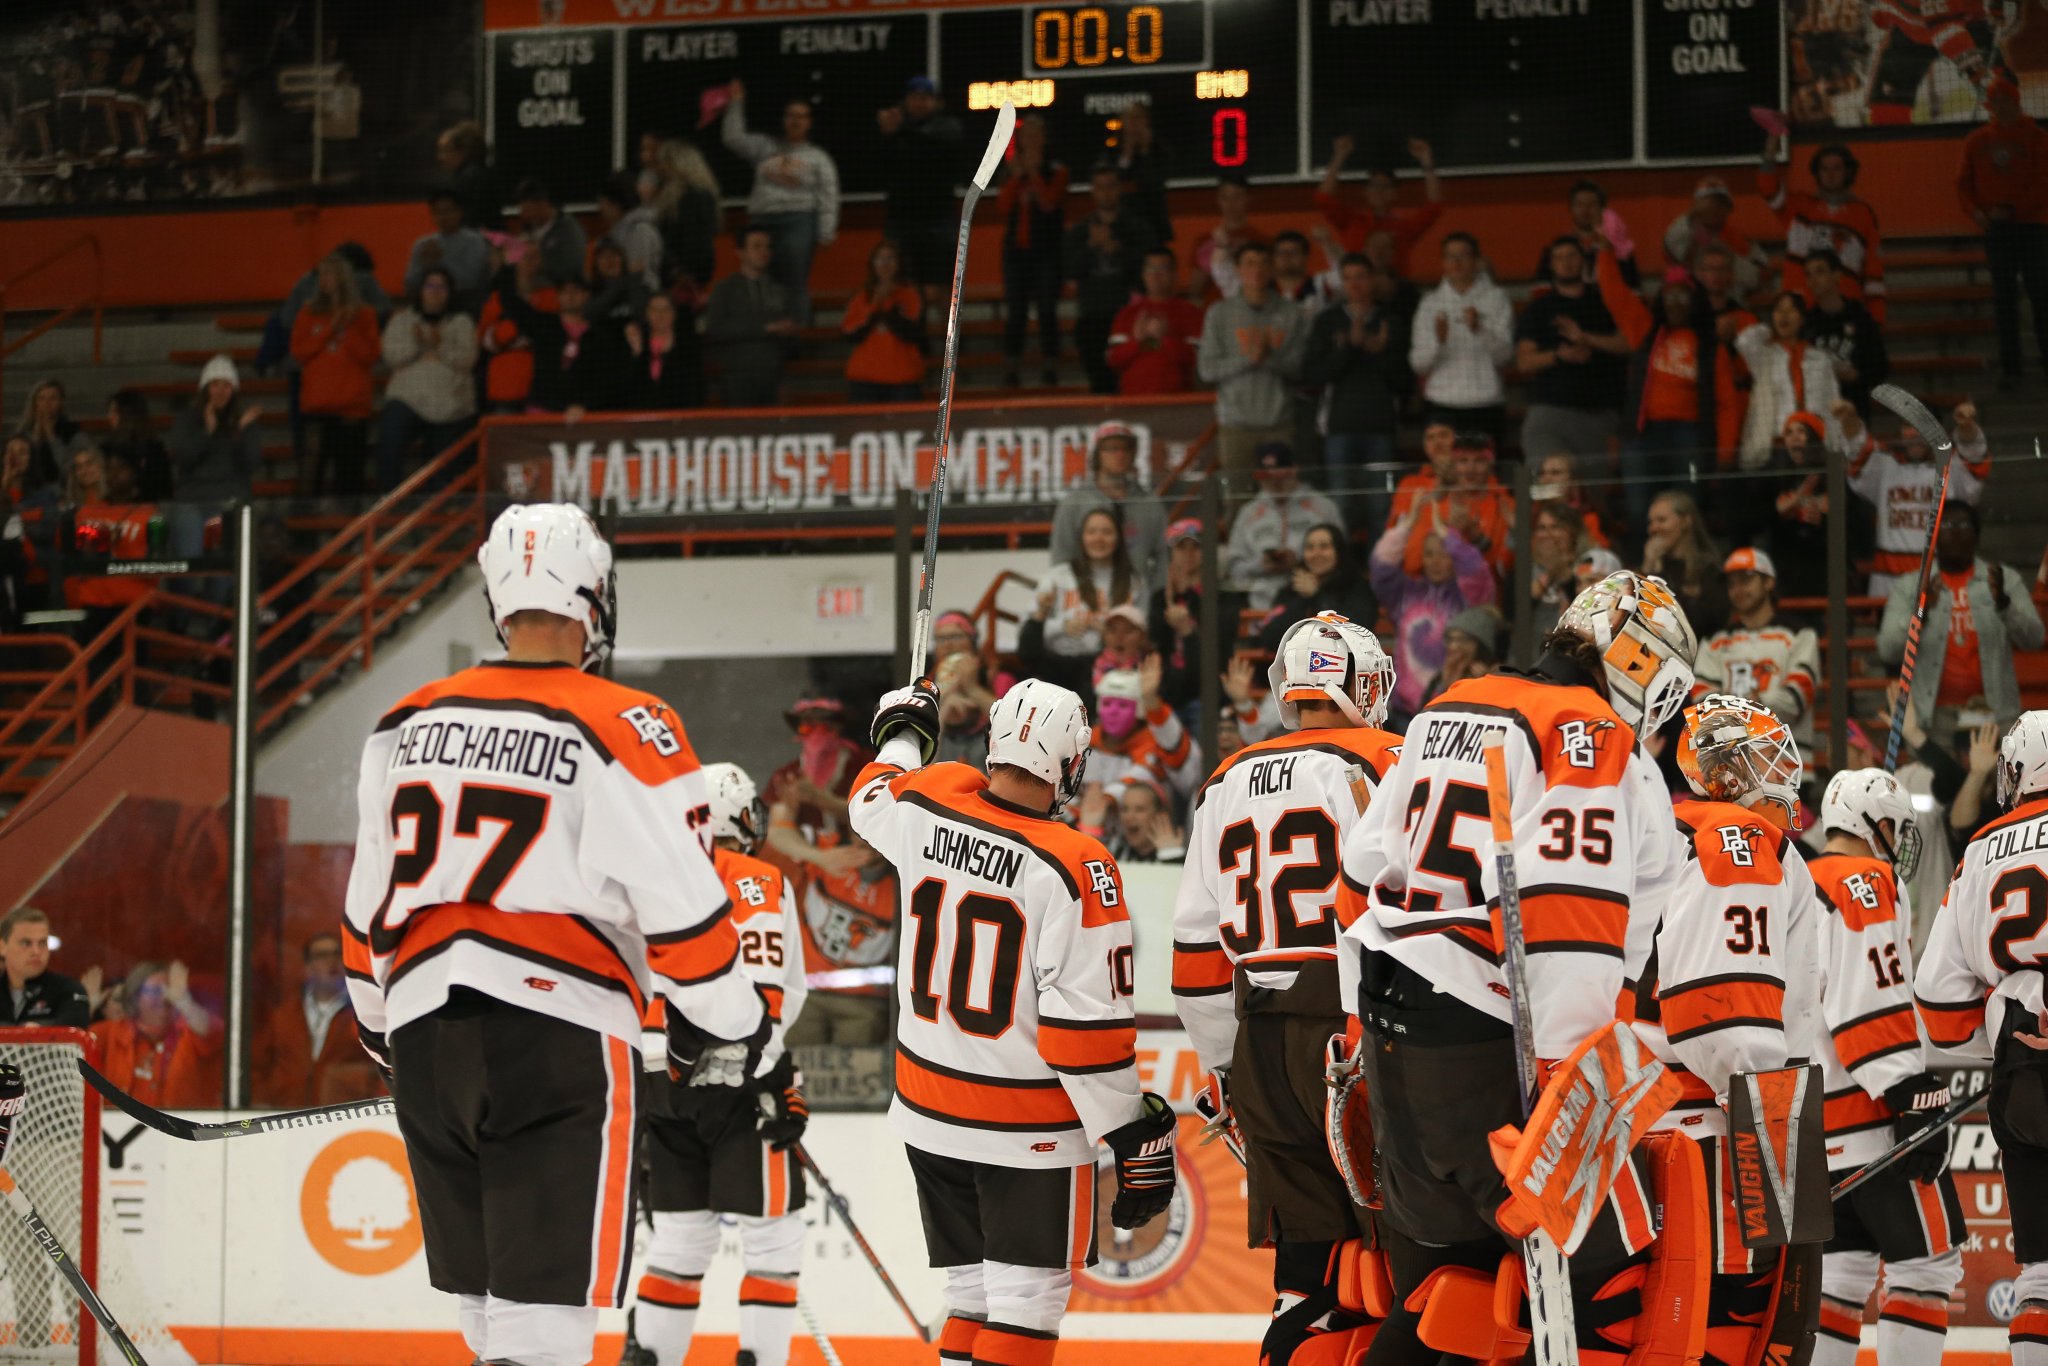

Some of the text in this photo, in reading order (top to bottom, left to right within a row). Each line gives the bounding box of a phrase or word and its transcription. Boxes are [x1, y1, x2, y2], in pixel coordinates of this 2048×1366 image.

[1329, 0, 1431, 27] PLAYER
[1689, 13, 1730, 42] ON
[511, 37, 595, 67] SHOTS
[643, 31, 739, 61] PLAYER
[780, 24, 892, 54] PENALTY
[1671, 44, 1746, 75] GOAL
[533, 69, 571, 97] ON
[517, 98, 585, 128] GOAL
[1212, 108, 1248, 167] 0
[550, 432, 836, 515] MADHOUSE
[849, 430, 920, 508] ON
[946, 424, 1152, 505] MERCR
[1249, 756, 1297, 799] RICH
[923, 824, 1024, 888] JOHNSON
[1538, 807, 1616, 866] 35
[369, 780, 552, 958] 27
[1218, 806, 1341, 955] 32
[740, 930, 784, 967] 25
[1724, 905, 1771, 956] 31
[910, 876, 1027, 1041] 10
[1106, 945, 1134, 1000] 10
[1867, 942, 1906, 990] 12
[260, 1101, 397, 1133] WARRIOR
[1522, 1078, 1591, 1198] VAUGHN
[1736, 1131, 1769, 1241] VAUGHN
